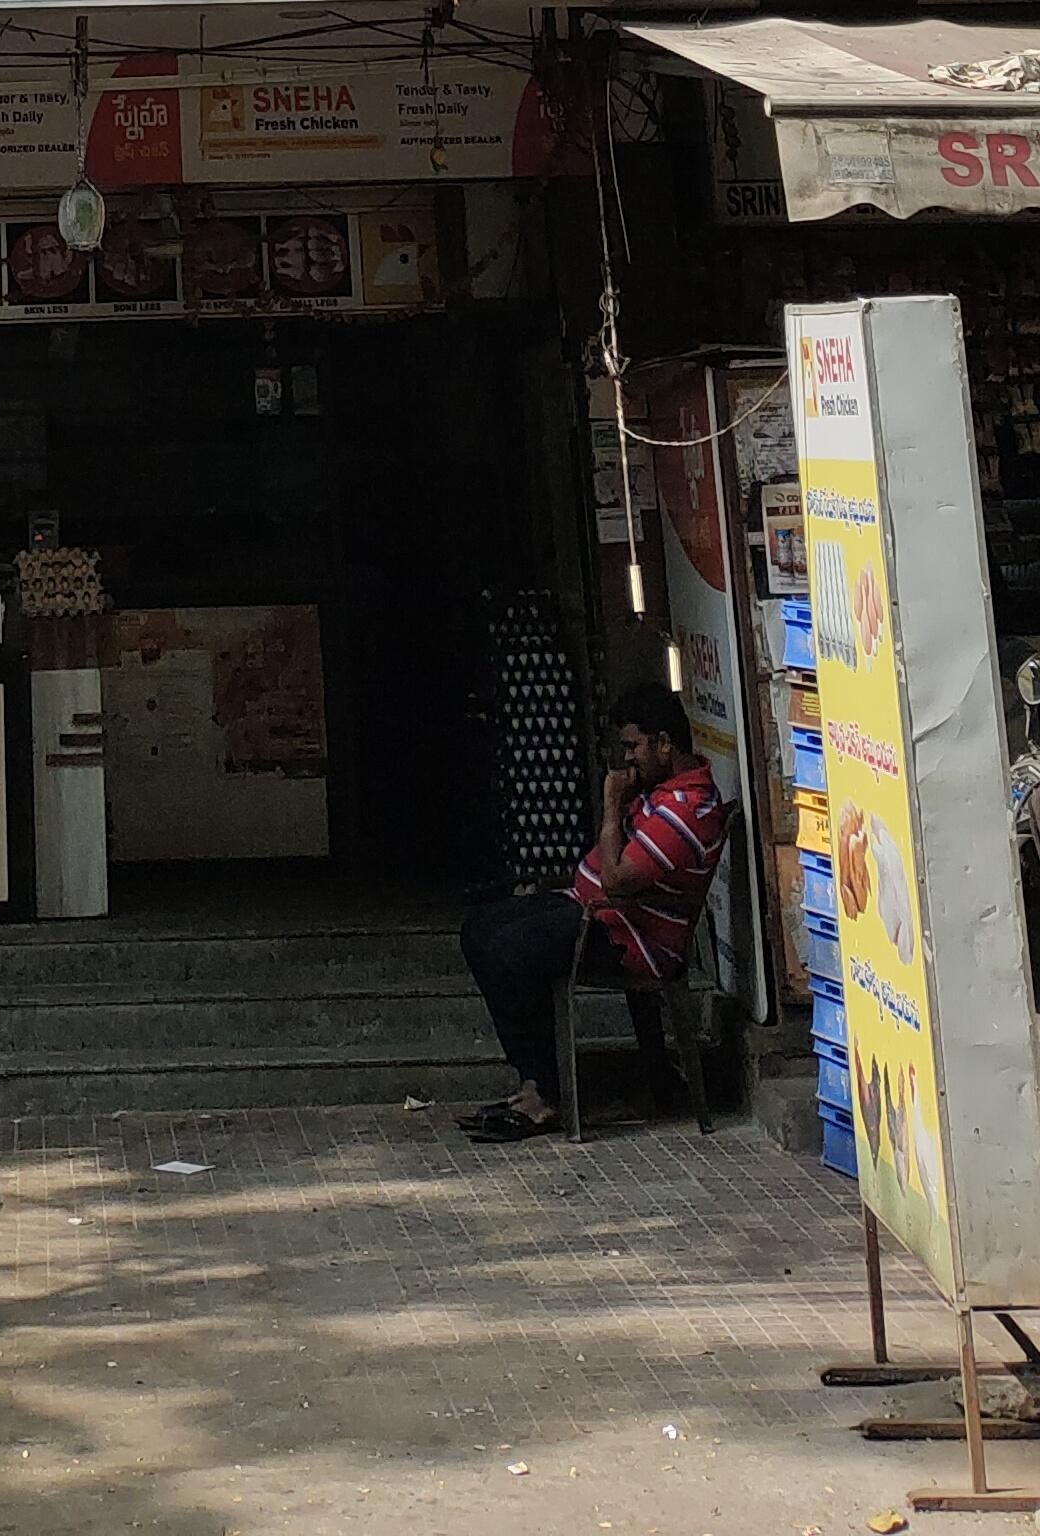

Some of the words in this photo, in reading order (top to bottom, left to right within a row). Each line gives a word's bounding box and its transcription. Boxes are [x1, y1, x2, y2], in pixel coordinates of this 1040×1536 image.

[442, 84, 452, 95] &
[253, 85, 356, 113] SNEHA
[398, 103, 432, 115] Fresh
[437, 102, 468, 116] Daily
[13, 110, 44, 125] Daily
[255, 117, 296, 131] Fresh
[299, 116, 360, 129] Chicken
[464, 135, 502, 145] DEALER
[815, 335, 856, 385] SNEHA
